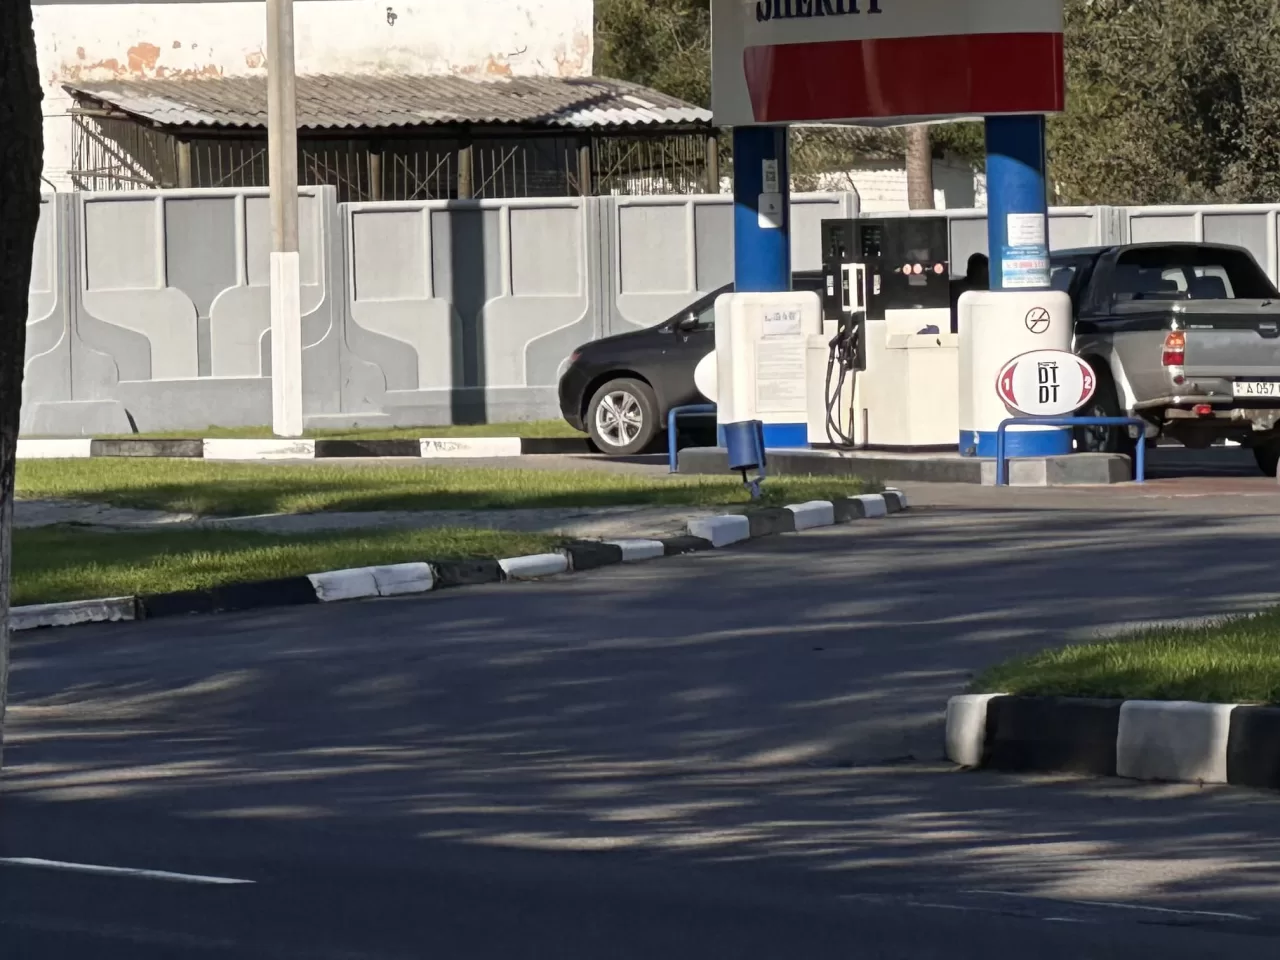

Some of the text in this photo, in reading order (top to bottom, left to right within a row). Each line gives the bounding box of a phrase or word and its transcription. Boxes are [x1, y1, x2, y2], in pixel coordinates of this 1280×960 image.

[1038, 366, 1059, 384] DT
[1084, 375, 1092, 389] 2
[1004, 378, 1010, 391] 1
[1039, 384, 1060, 404] DT
